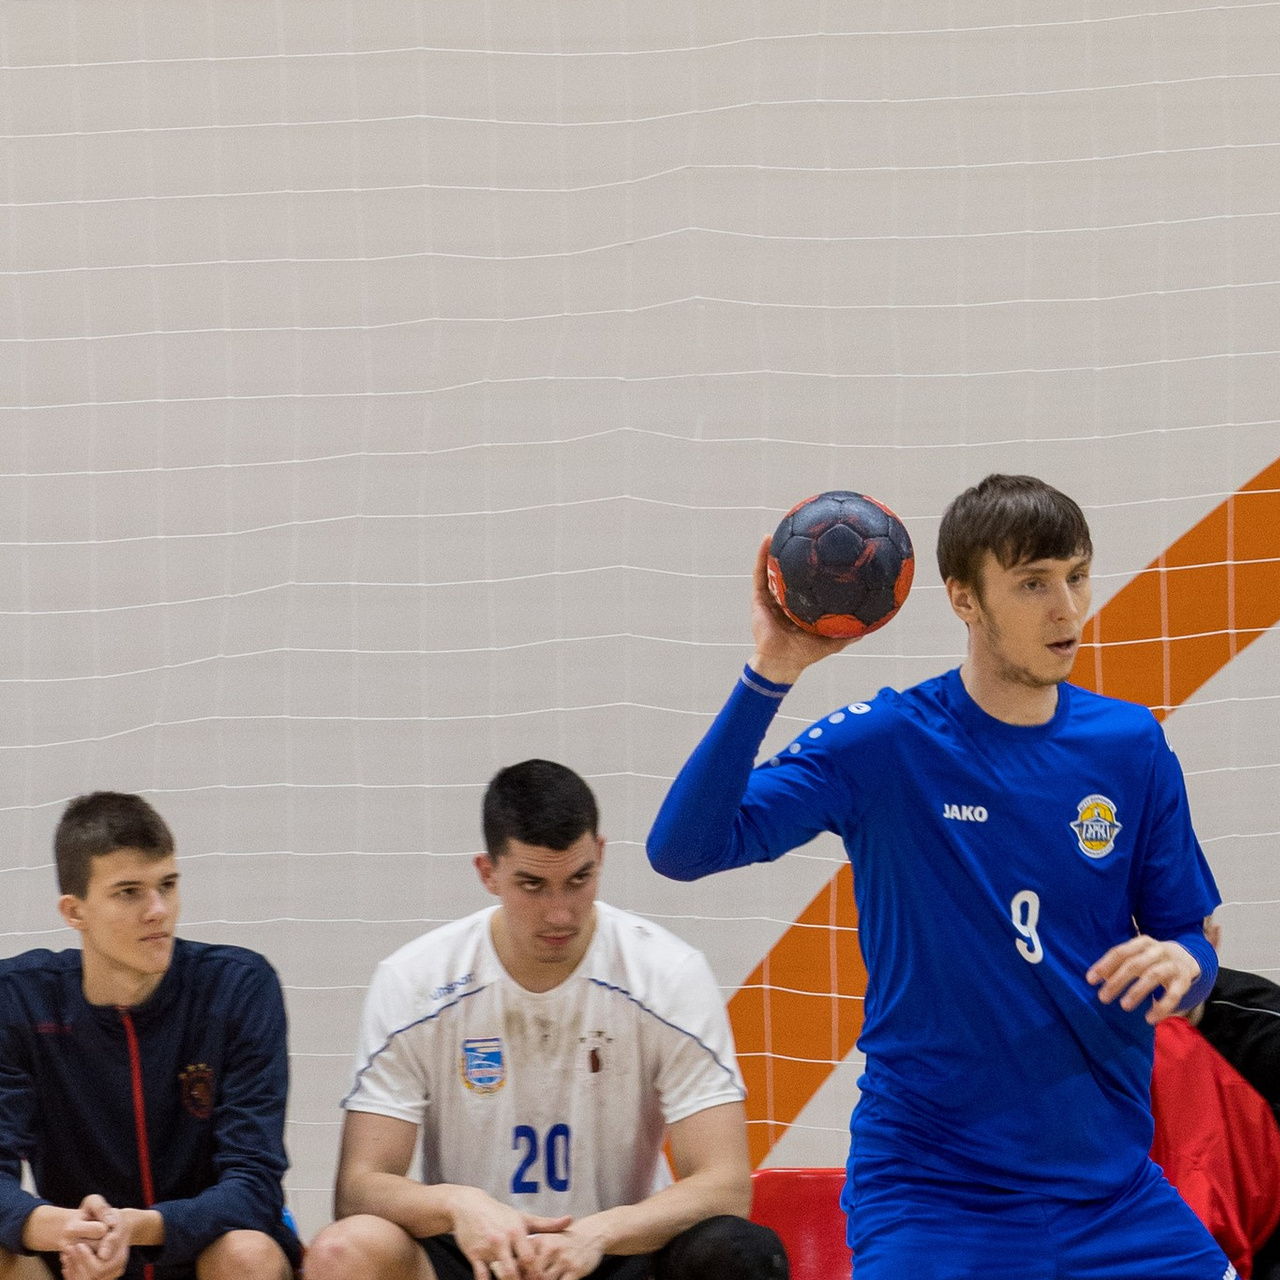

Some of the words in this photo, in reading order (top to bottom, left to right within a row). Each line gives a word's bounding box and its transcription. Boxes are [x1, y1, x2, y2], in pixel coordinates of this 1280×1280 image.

[942, 802, 989, 823] JAKO
[1010, 889, 1044, 965] 9
[509, 1123, 570, 1194] 20
